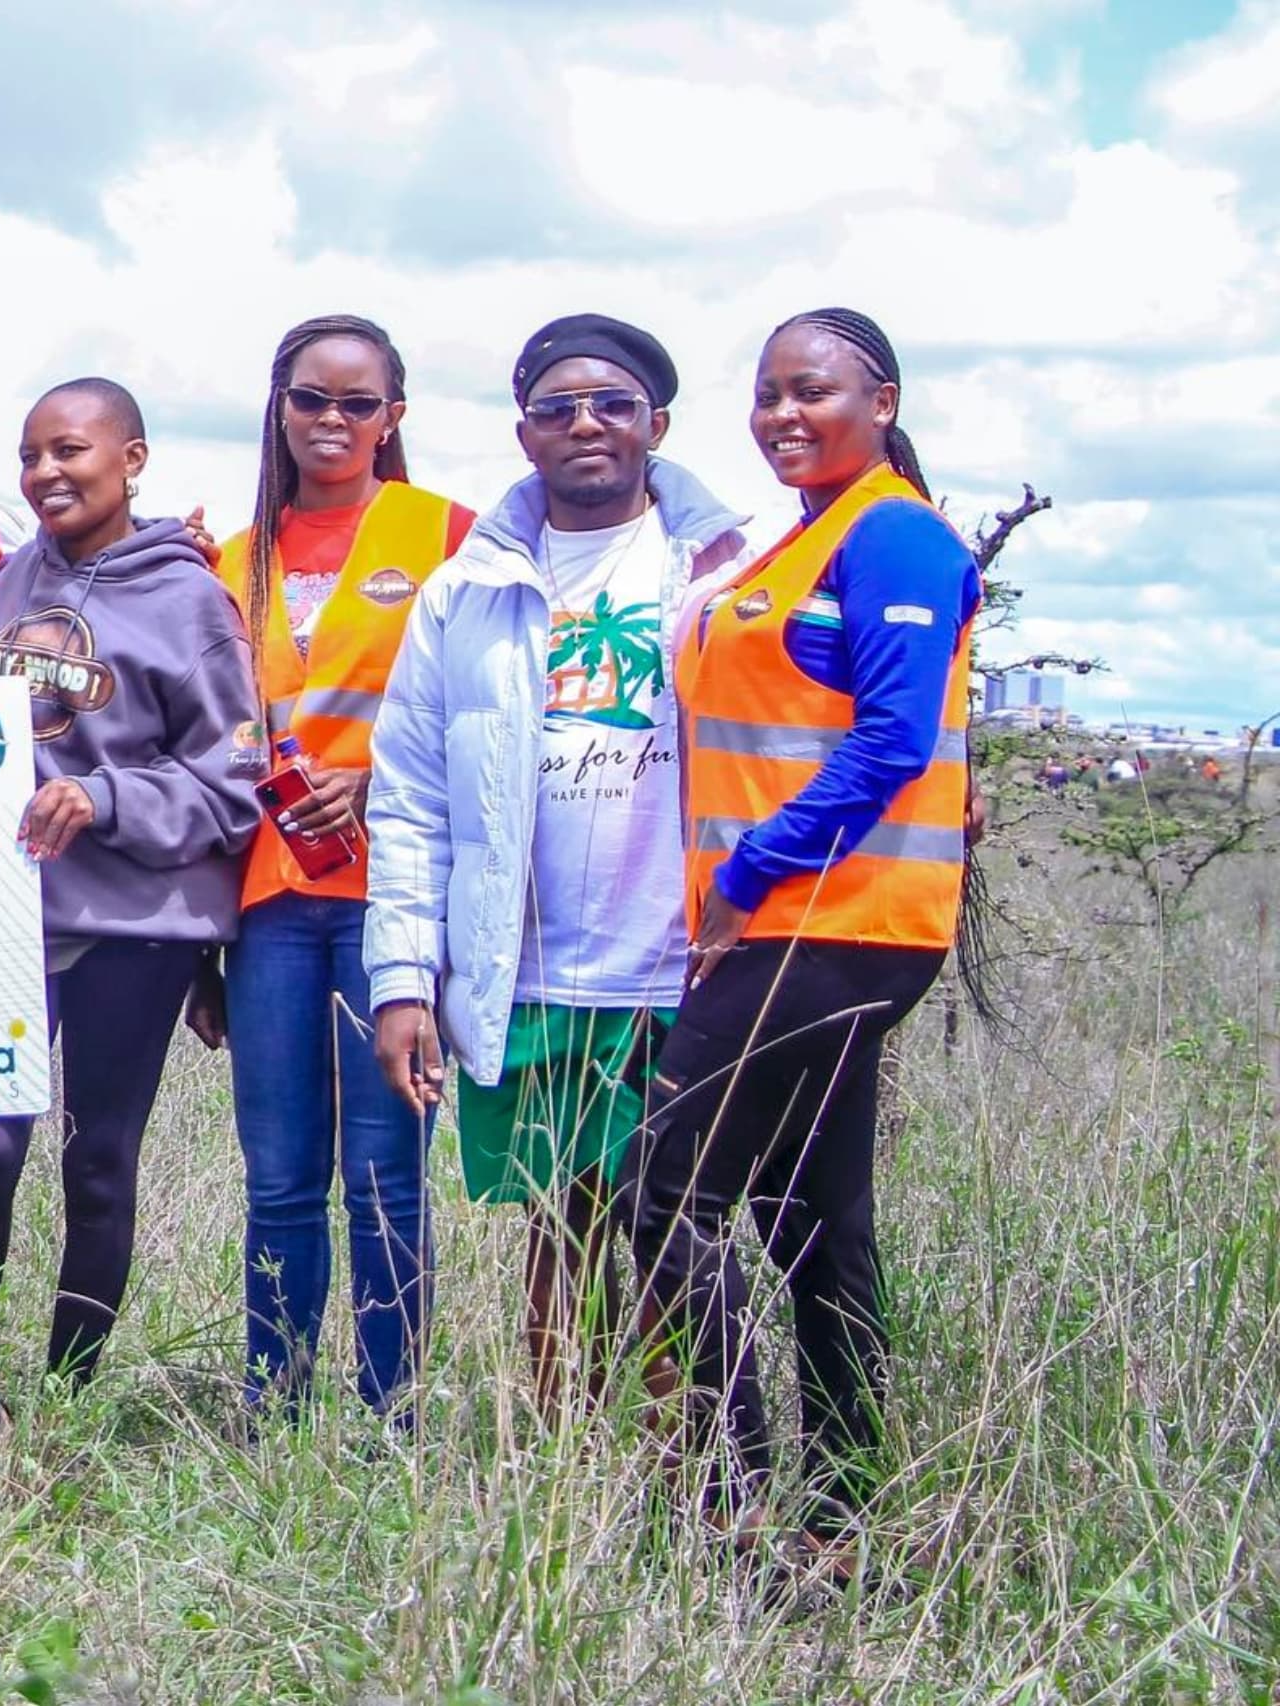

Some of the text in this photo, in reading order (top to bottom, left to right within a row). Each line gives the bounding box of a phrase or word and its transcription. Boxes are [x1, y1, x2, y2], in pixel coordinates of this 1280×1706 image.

[25, 652, 89, 692] WOOD
[574, 739, 629, 784] for
[551, 788, 630, 802] HAVE FUN!
